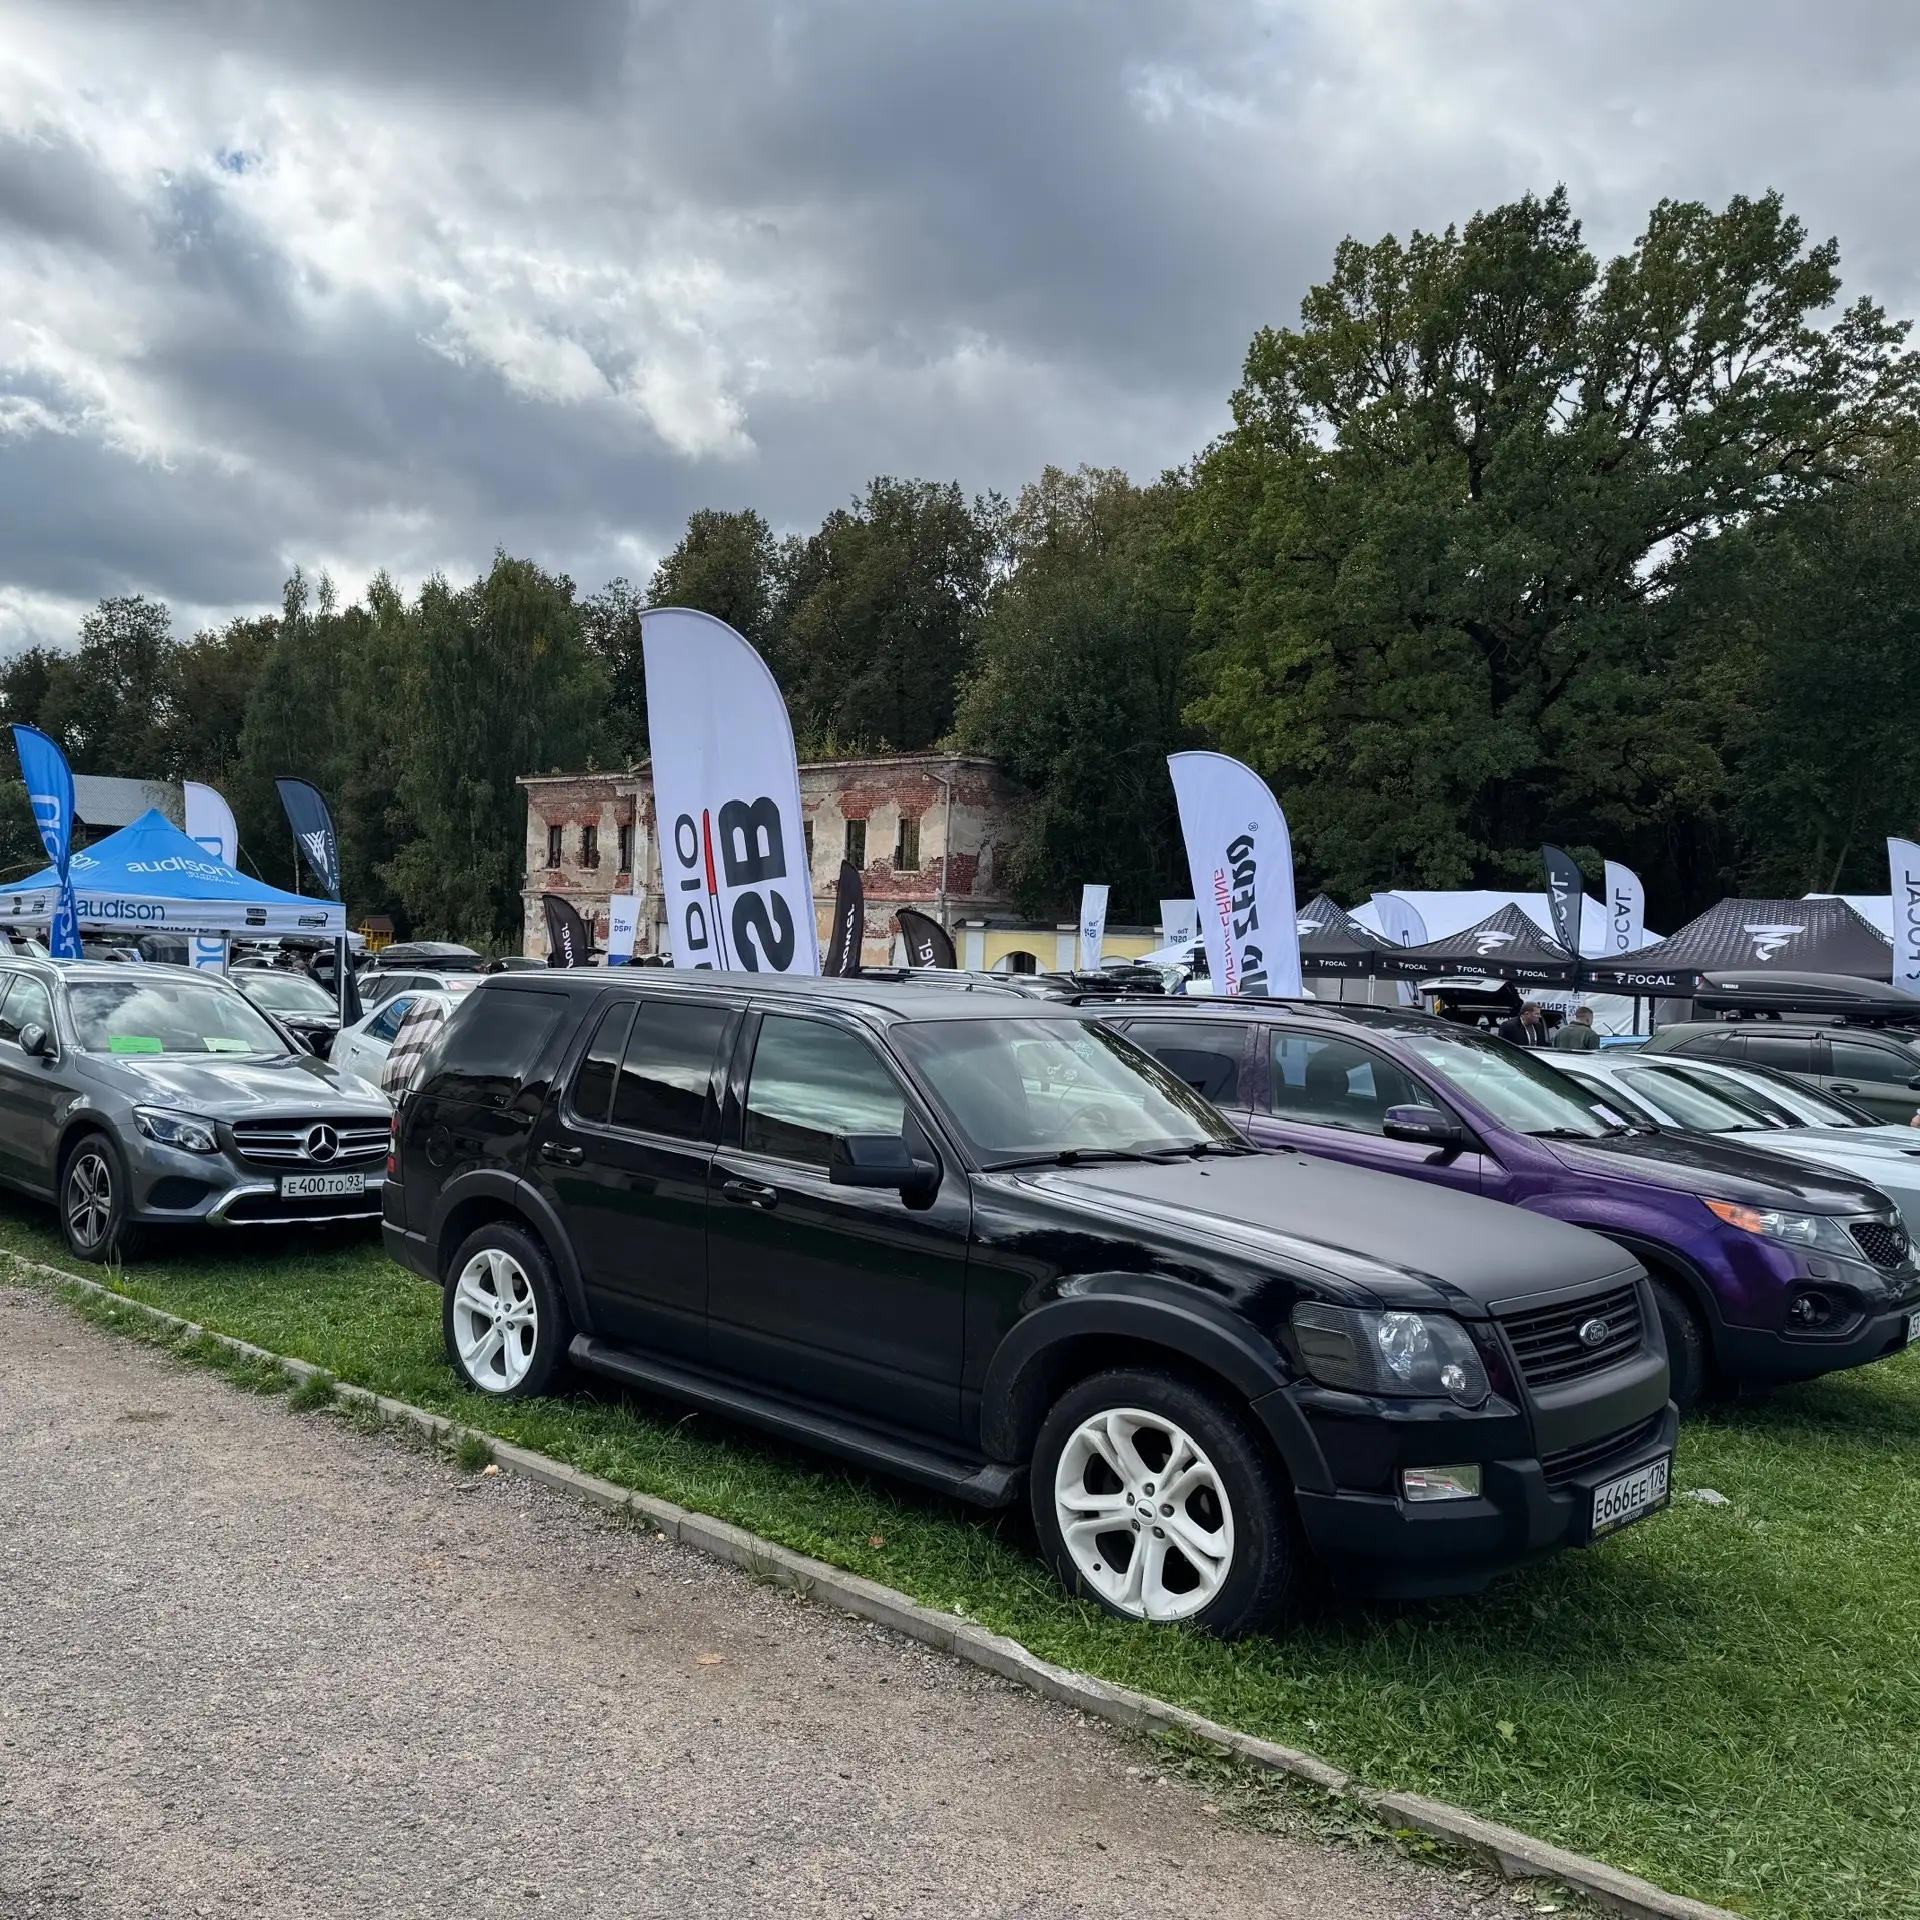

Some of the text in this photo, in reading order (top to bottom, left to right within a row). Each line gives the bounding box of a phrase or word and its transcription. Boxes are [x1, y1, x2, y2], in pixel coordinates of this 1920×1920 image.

[126, 856, 234, 879] audison
[76, 899, 165, 921] audison
[1404, 963, 1428, 971] FOCAL
[1463, 966, 1487, 974] FOCAL
[1522, 970, 1549, 978] FOCAL
[1627, 974, 1676, 986] FOCAL
[1648, 1462, 1666, 1490] 178
